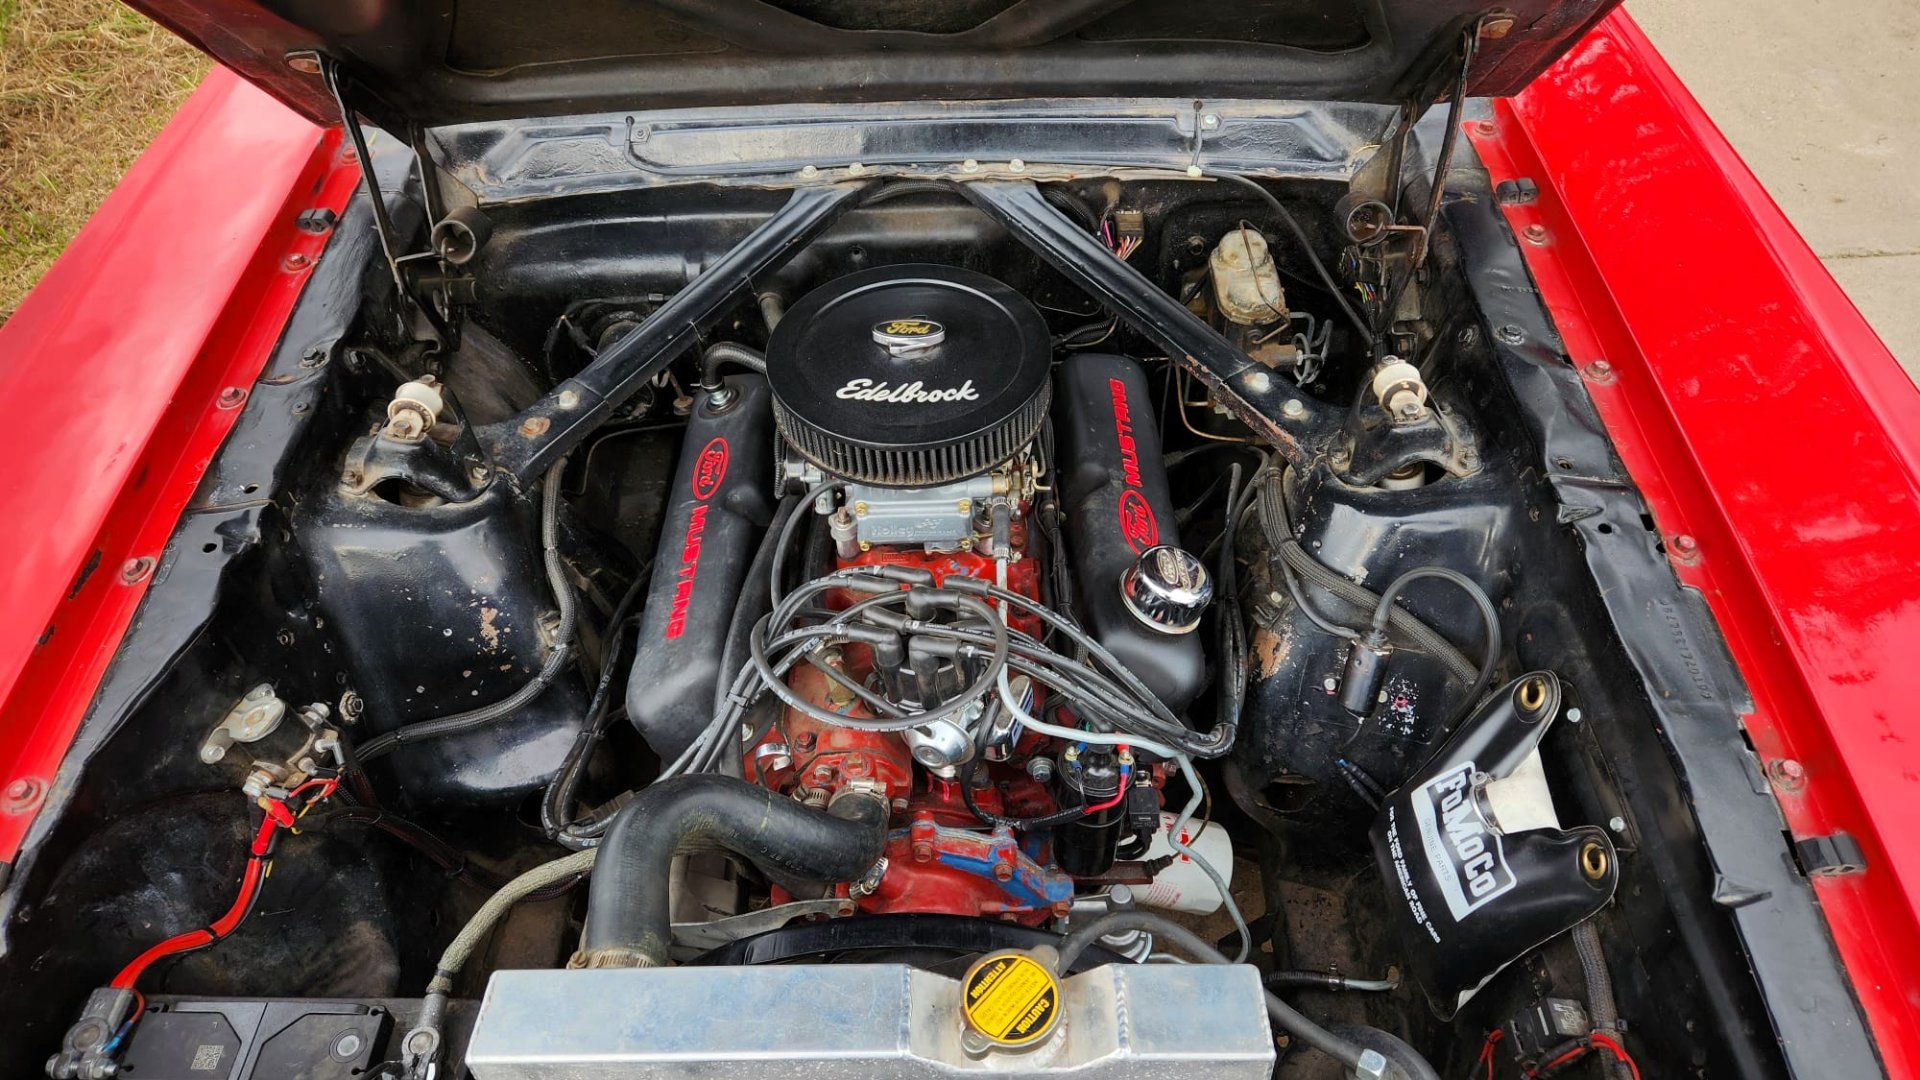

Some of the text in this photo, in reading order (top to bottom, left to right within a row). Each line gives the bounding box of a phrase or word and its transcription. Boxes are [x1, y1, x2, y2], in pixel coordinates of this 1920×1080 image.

[886, 321, 930, 334] Ford
[836, 378, 979, 403] Edelbrock
[1109, 378, 1143, 487] MUSTANG
[699, 449, 724, 487] Ford
[1126, 502, 1151, 546] Ford
[665, 504, 709, 640] MUSTANG
[1436, 771, 1497, 898] FoMoCo
[1390, 842, 1398, 859] THE
[1394, 860, 1411, 900] AMERICAN
[1409, 898, 1422, 924] ROAD
[1393, 837, 1403, 859] FORD
[1400, 859, 1413, 886] FAMILY
[1410, 889, 1418, 900] OF
[1415, 901, 1427, 921] FINE
[1425, 921, 1441, 943] CARS
[1016, 998, 1050, 1034] CAUTION
